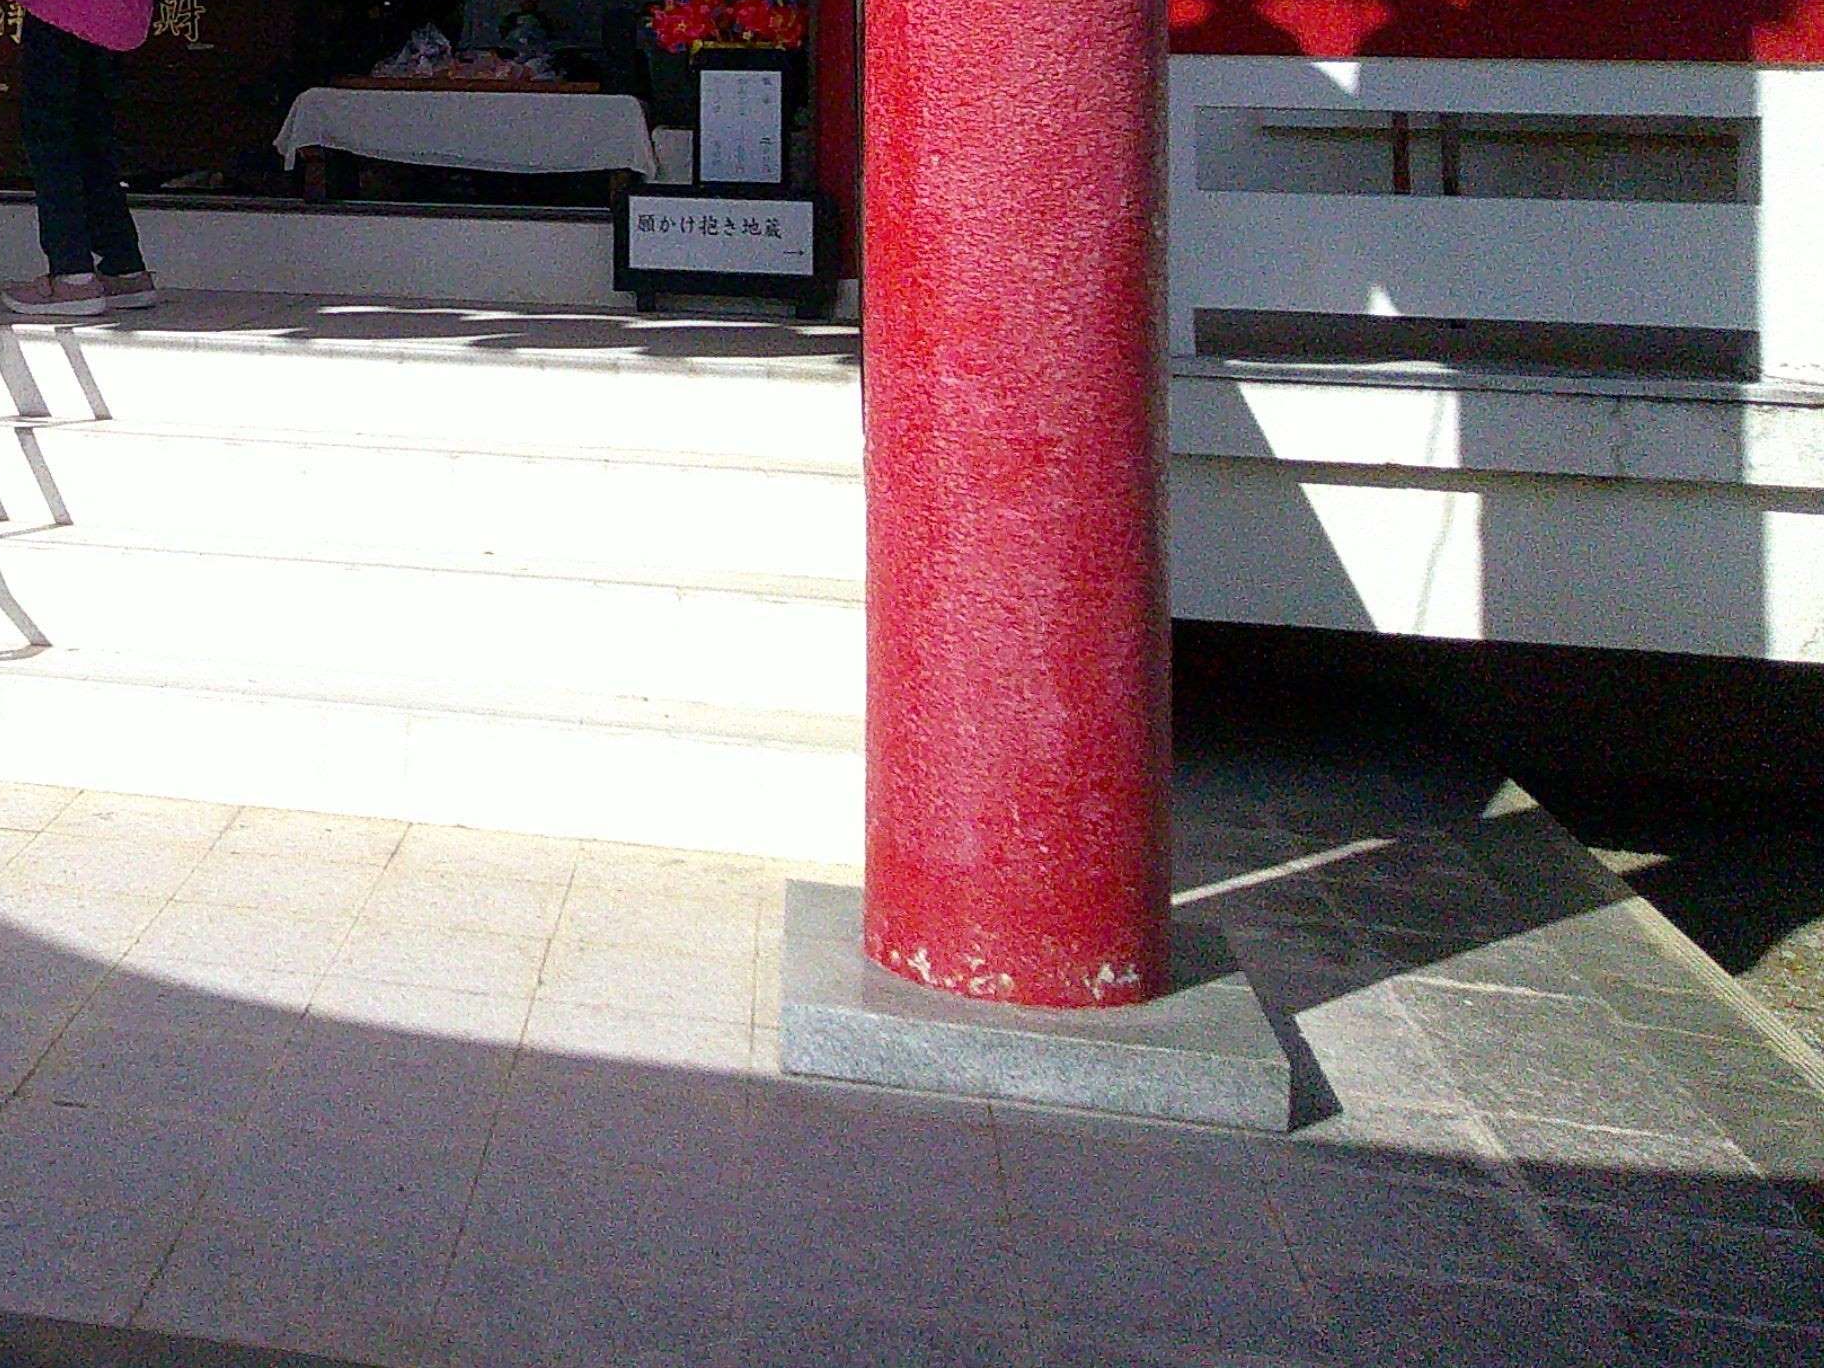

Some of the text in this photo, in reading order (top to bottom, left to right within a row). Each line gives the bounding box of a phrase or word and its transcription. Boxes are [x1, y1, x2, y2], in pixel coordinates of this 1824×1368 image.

[636, 213, 783, 241] 願かけ抱き地蔵
